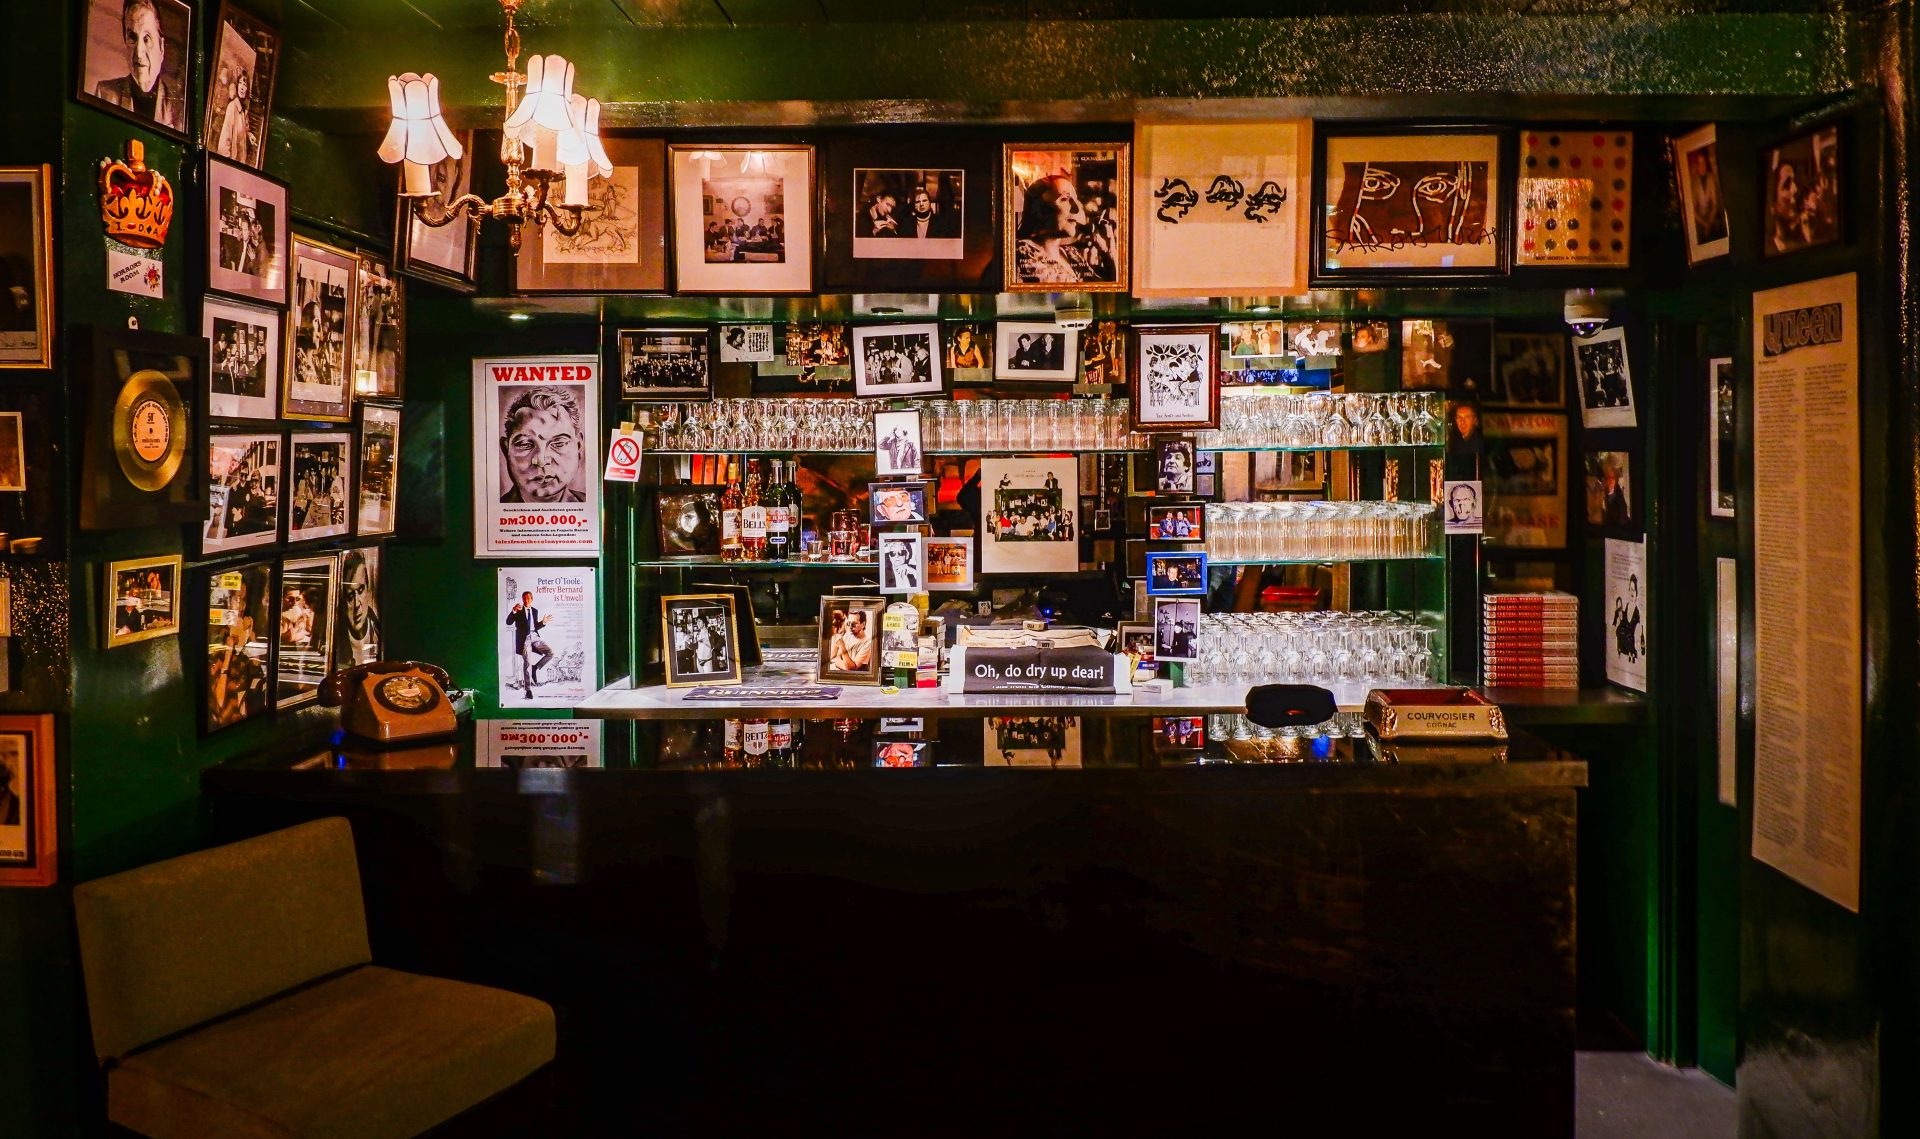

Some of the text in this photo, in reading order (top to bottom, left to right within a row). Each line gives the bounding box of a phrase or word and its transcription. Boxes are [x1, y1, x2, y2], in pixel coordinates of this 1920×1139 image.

[112, 260, 142, 279] HORRORS
[120, 270, 140, 283] ROOM
[492, 366, 592, 381] WANTED
[499, 515, 588, 527] DM300.000,-
[537, 577, 554, 585] Peter
[536, 586, 557, 594] Jeffrey
[974, 664, 1104, 679] Oh, do dry up dear!
[1407, 712, 1476, 721] COURVOISIER
